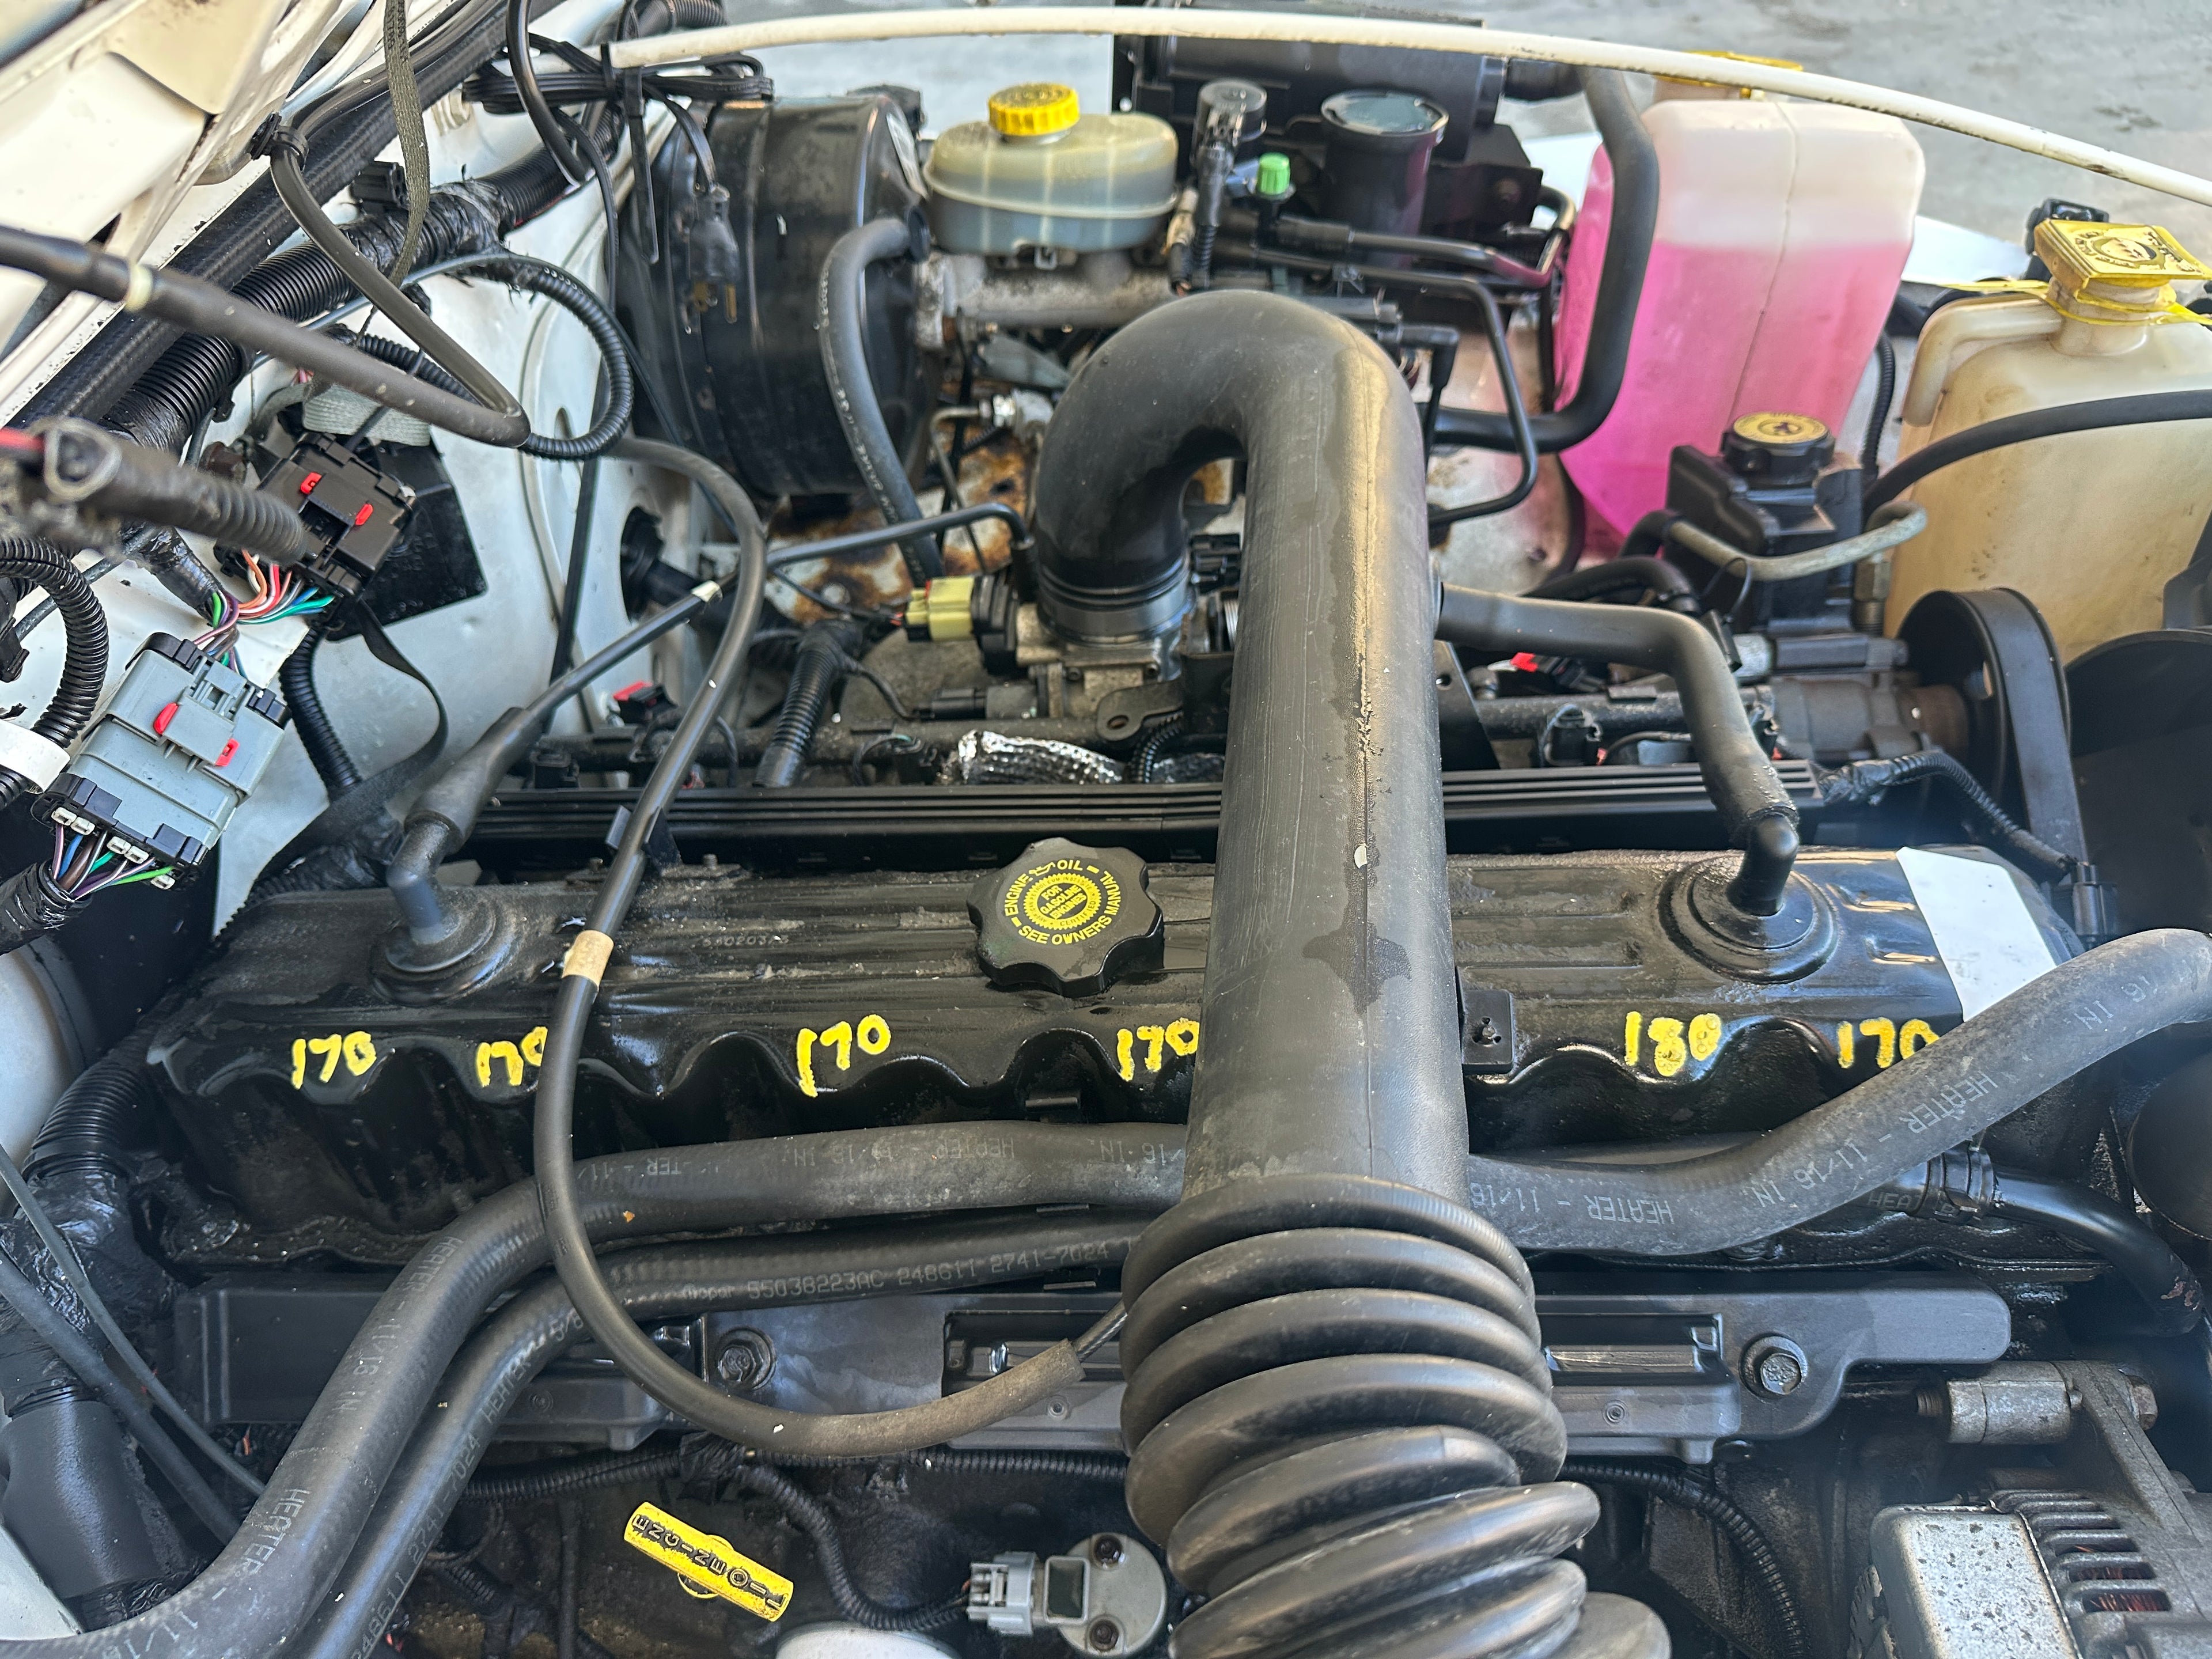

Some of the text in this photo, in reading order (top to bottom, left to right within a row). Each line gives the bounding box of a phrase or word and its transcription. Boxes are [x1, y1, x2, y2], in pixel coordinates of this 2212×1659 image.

[1005, 859, 1083, 916] ENGINE OIL
[1018, 870, 1121, 945] SEE OWNERS MANUAL
[1039, 884, 1082, 914] GASOLINE
[1041, 885, 1062, 901] FOR
[1049, 893, 1087, 919] ENGINES
[291, 1031, 377, 1089] 170
[476, 1026, 548, 1088] 170
[796, 1014, 892, 1097] 170
[1116, 1017, 1199, 1081] 170
[1624, 1011, 1721, 1077] 180
[1837, 1017, 1940, 1069] 170
[1899, 1071, 1998, 1134] HEATER
[1793, 1141, 1868, 1190] 11/16
[1469, 1182, 1540, 1213] 11/16
[1584, 1194, 1675, 1225] HEATER
[402, 1236, 464, 1293] HEATER
[747, 1268, 885, 1300] 55038223AC
[896, 1257, 978, 1286] 248611
[990, 1240, 1110, 1274] 2741-7024
[240, 1488, 310, 1577] HEATER
[631, 1514, 790, 1611] ENGINE OIL
